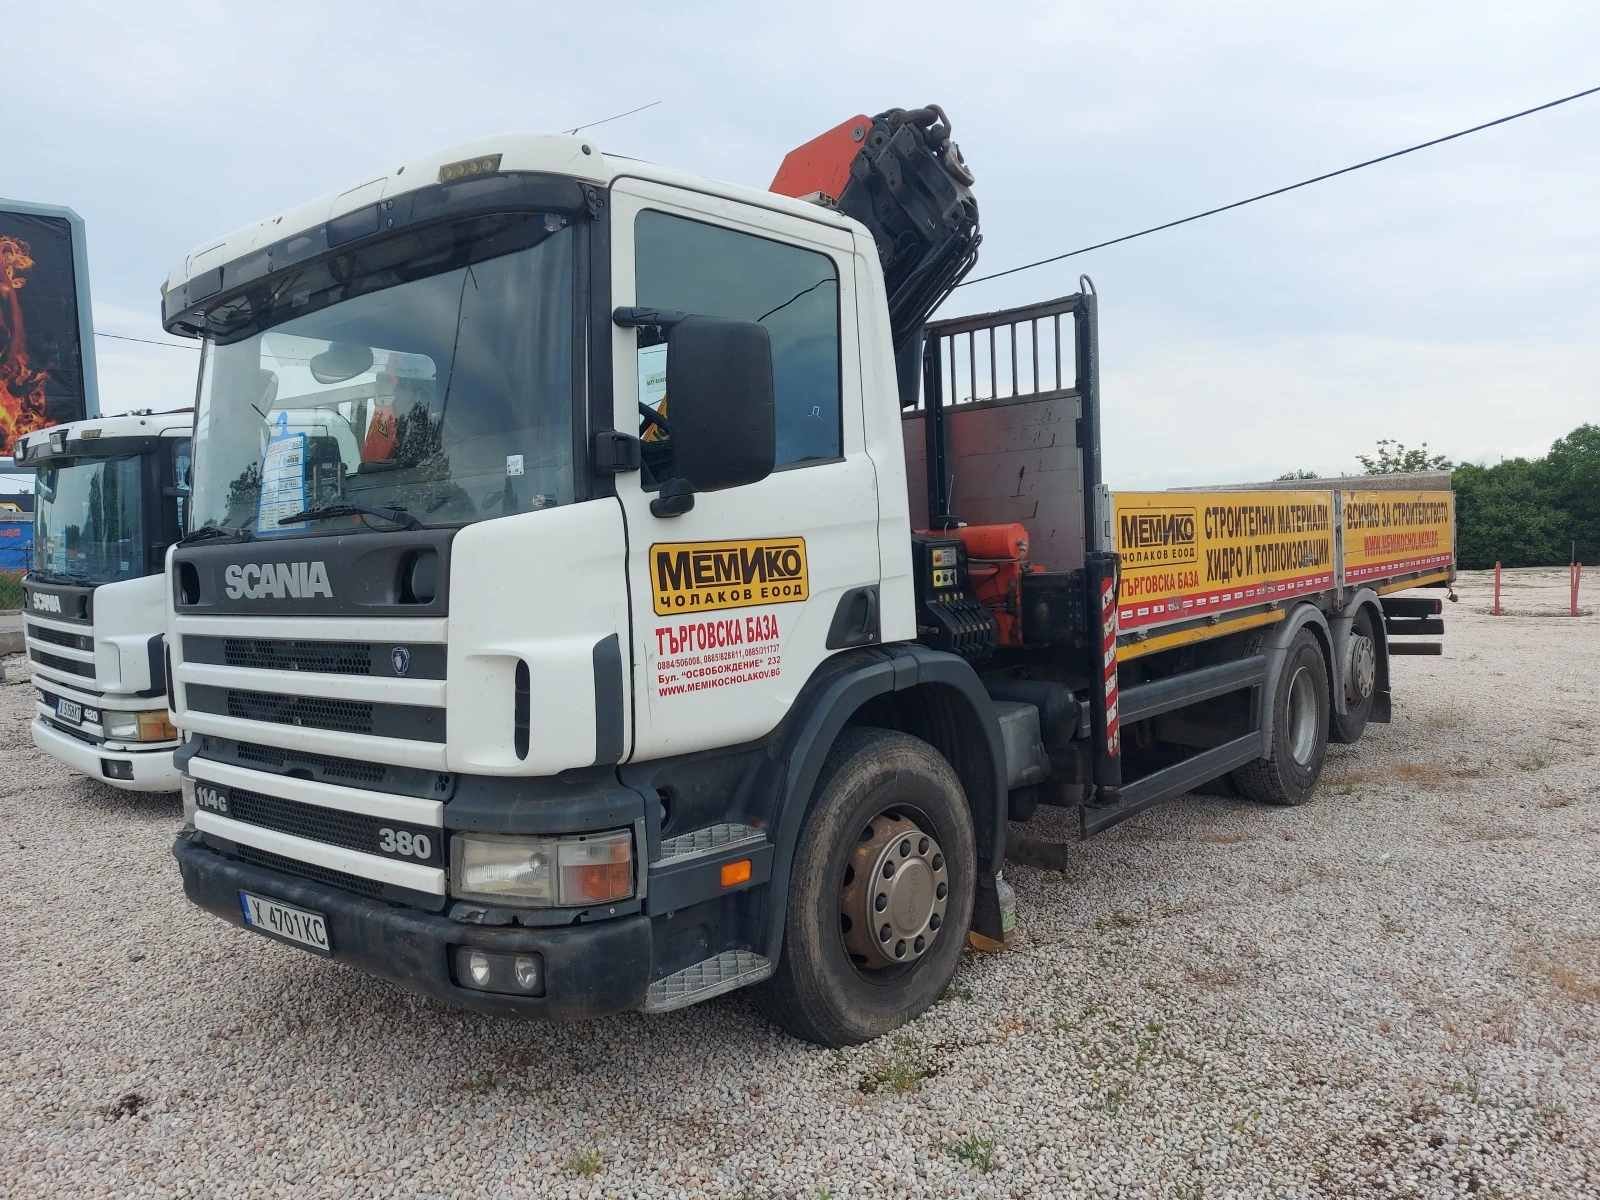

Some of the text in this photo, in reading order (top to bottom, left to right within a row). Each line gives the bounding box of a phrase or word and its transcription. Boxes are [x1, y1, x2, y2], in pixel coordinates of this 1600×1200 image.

[1204, 505, 1328, 539] СТРОИТЕЛНИ МАТЕРИАЛИ
[1347, 503, 1380, 529] ВСИЧКО
[1381, 503, 1391, 527] ЗА
[1122, 548, 1195, 563] ЧОЛАКОВ ЕООД
[1206, 546, 1243, 584] ХИДРО
[1245, 546, 1253, 576] И
[225, 562, 333, 599] SCANIA
[1120, 570, 1199, 597] ТЪРГОВСКА БАЗА
[33, 592, 61, 613] SCANIA
[660, 584, 802, 608] ЧОЛАКОВ ЕООД
[656, 614, 779, 655] ТЪРГОВСКА БАЗА
[767, 655, 781, 665] 232
[658, 668, 781, 697] WWW.MEMIKOCHOLAKOV.BG
[84, 709, 98, 722] 420
[379, 828, 431, 859] 380
